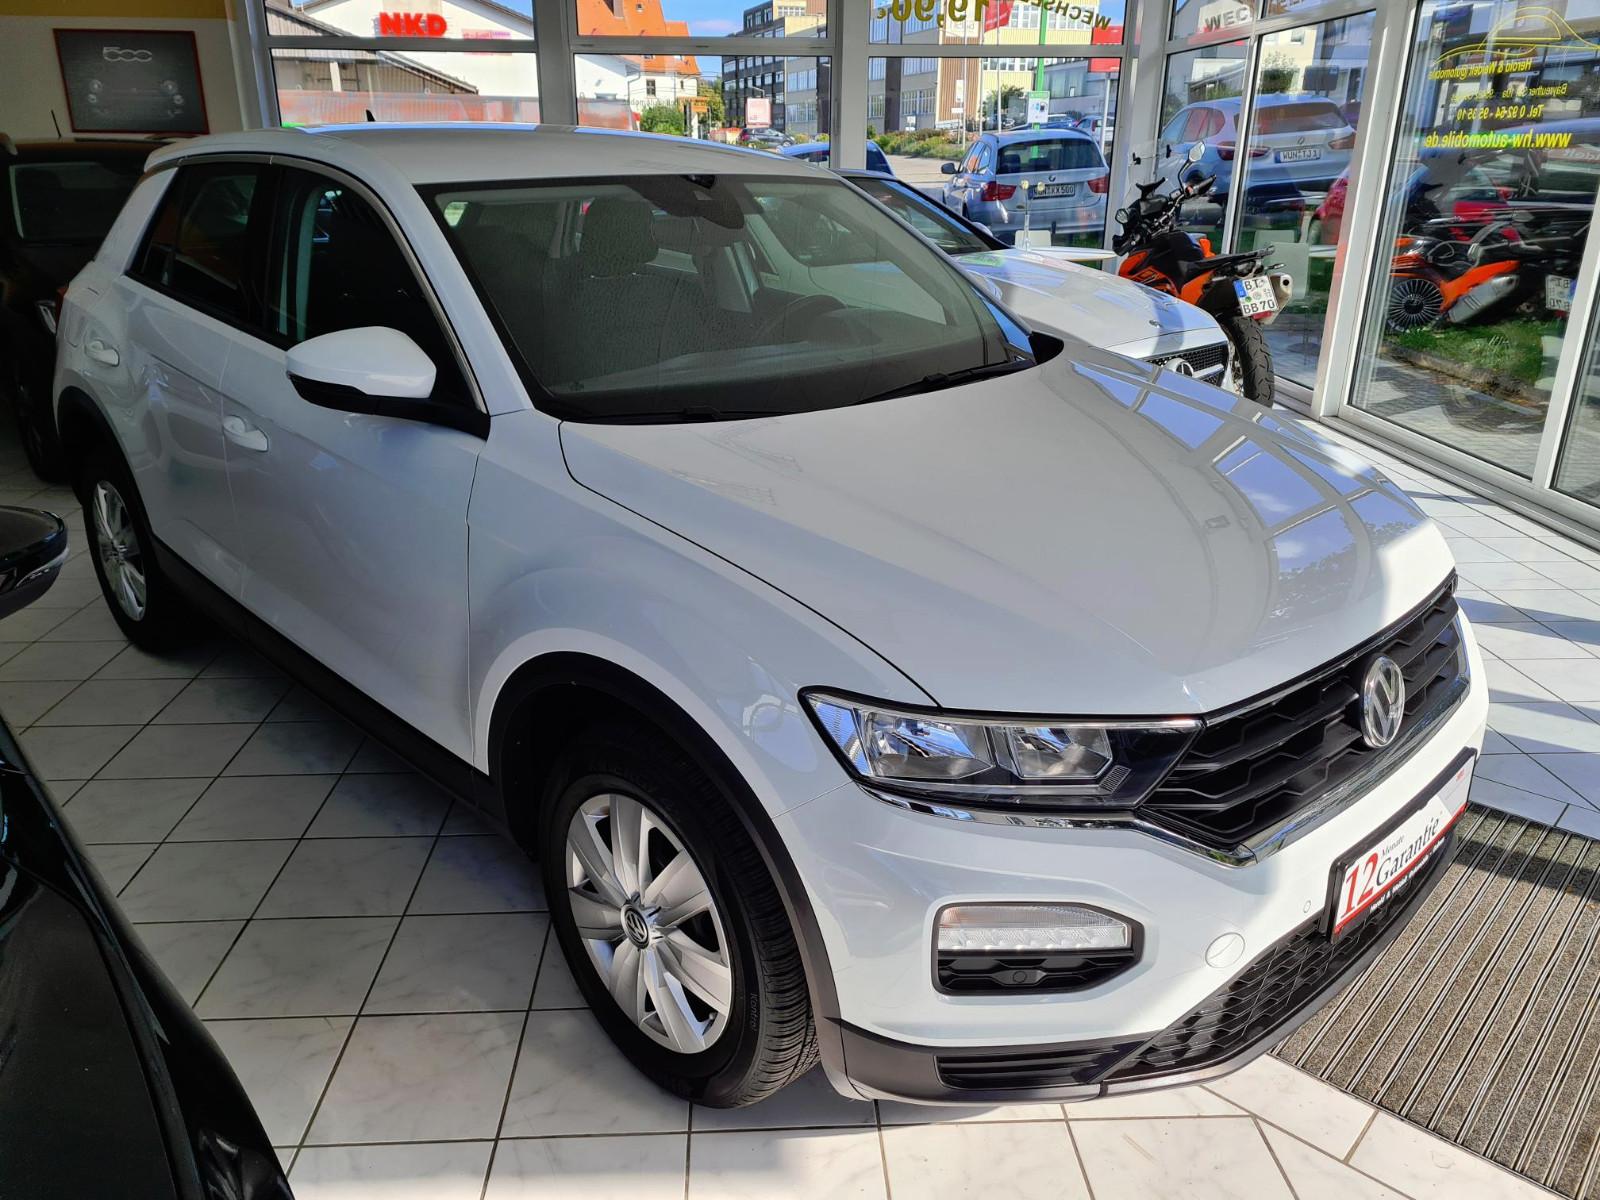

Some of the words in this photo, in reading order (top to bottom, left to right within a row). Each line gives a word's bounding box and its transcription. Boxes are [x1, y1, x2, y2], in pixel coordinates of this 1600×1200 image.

[379, 11, 447, 37] NKD
[102, 46, 153, 62] 500
[1244, 279, 1260, 290] BT
[1376, 816, 1440, 887] Garantie
